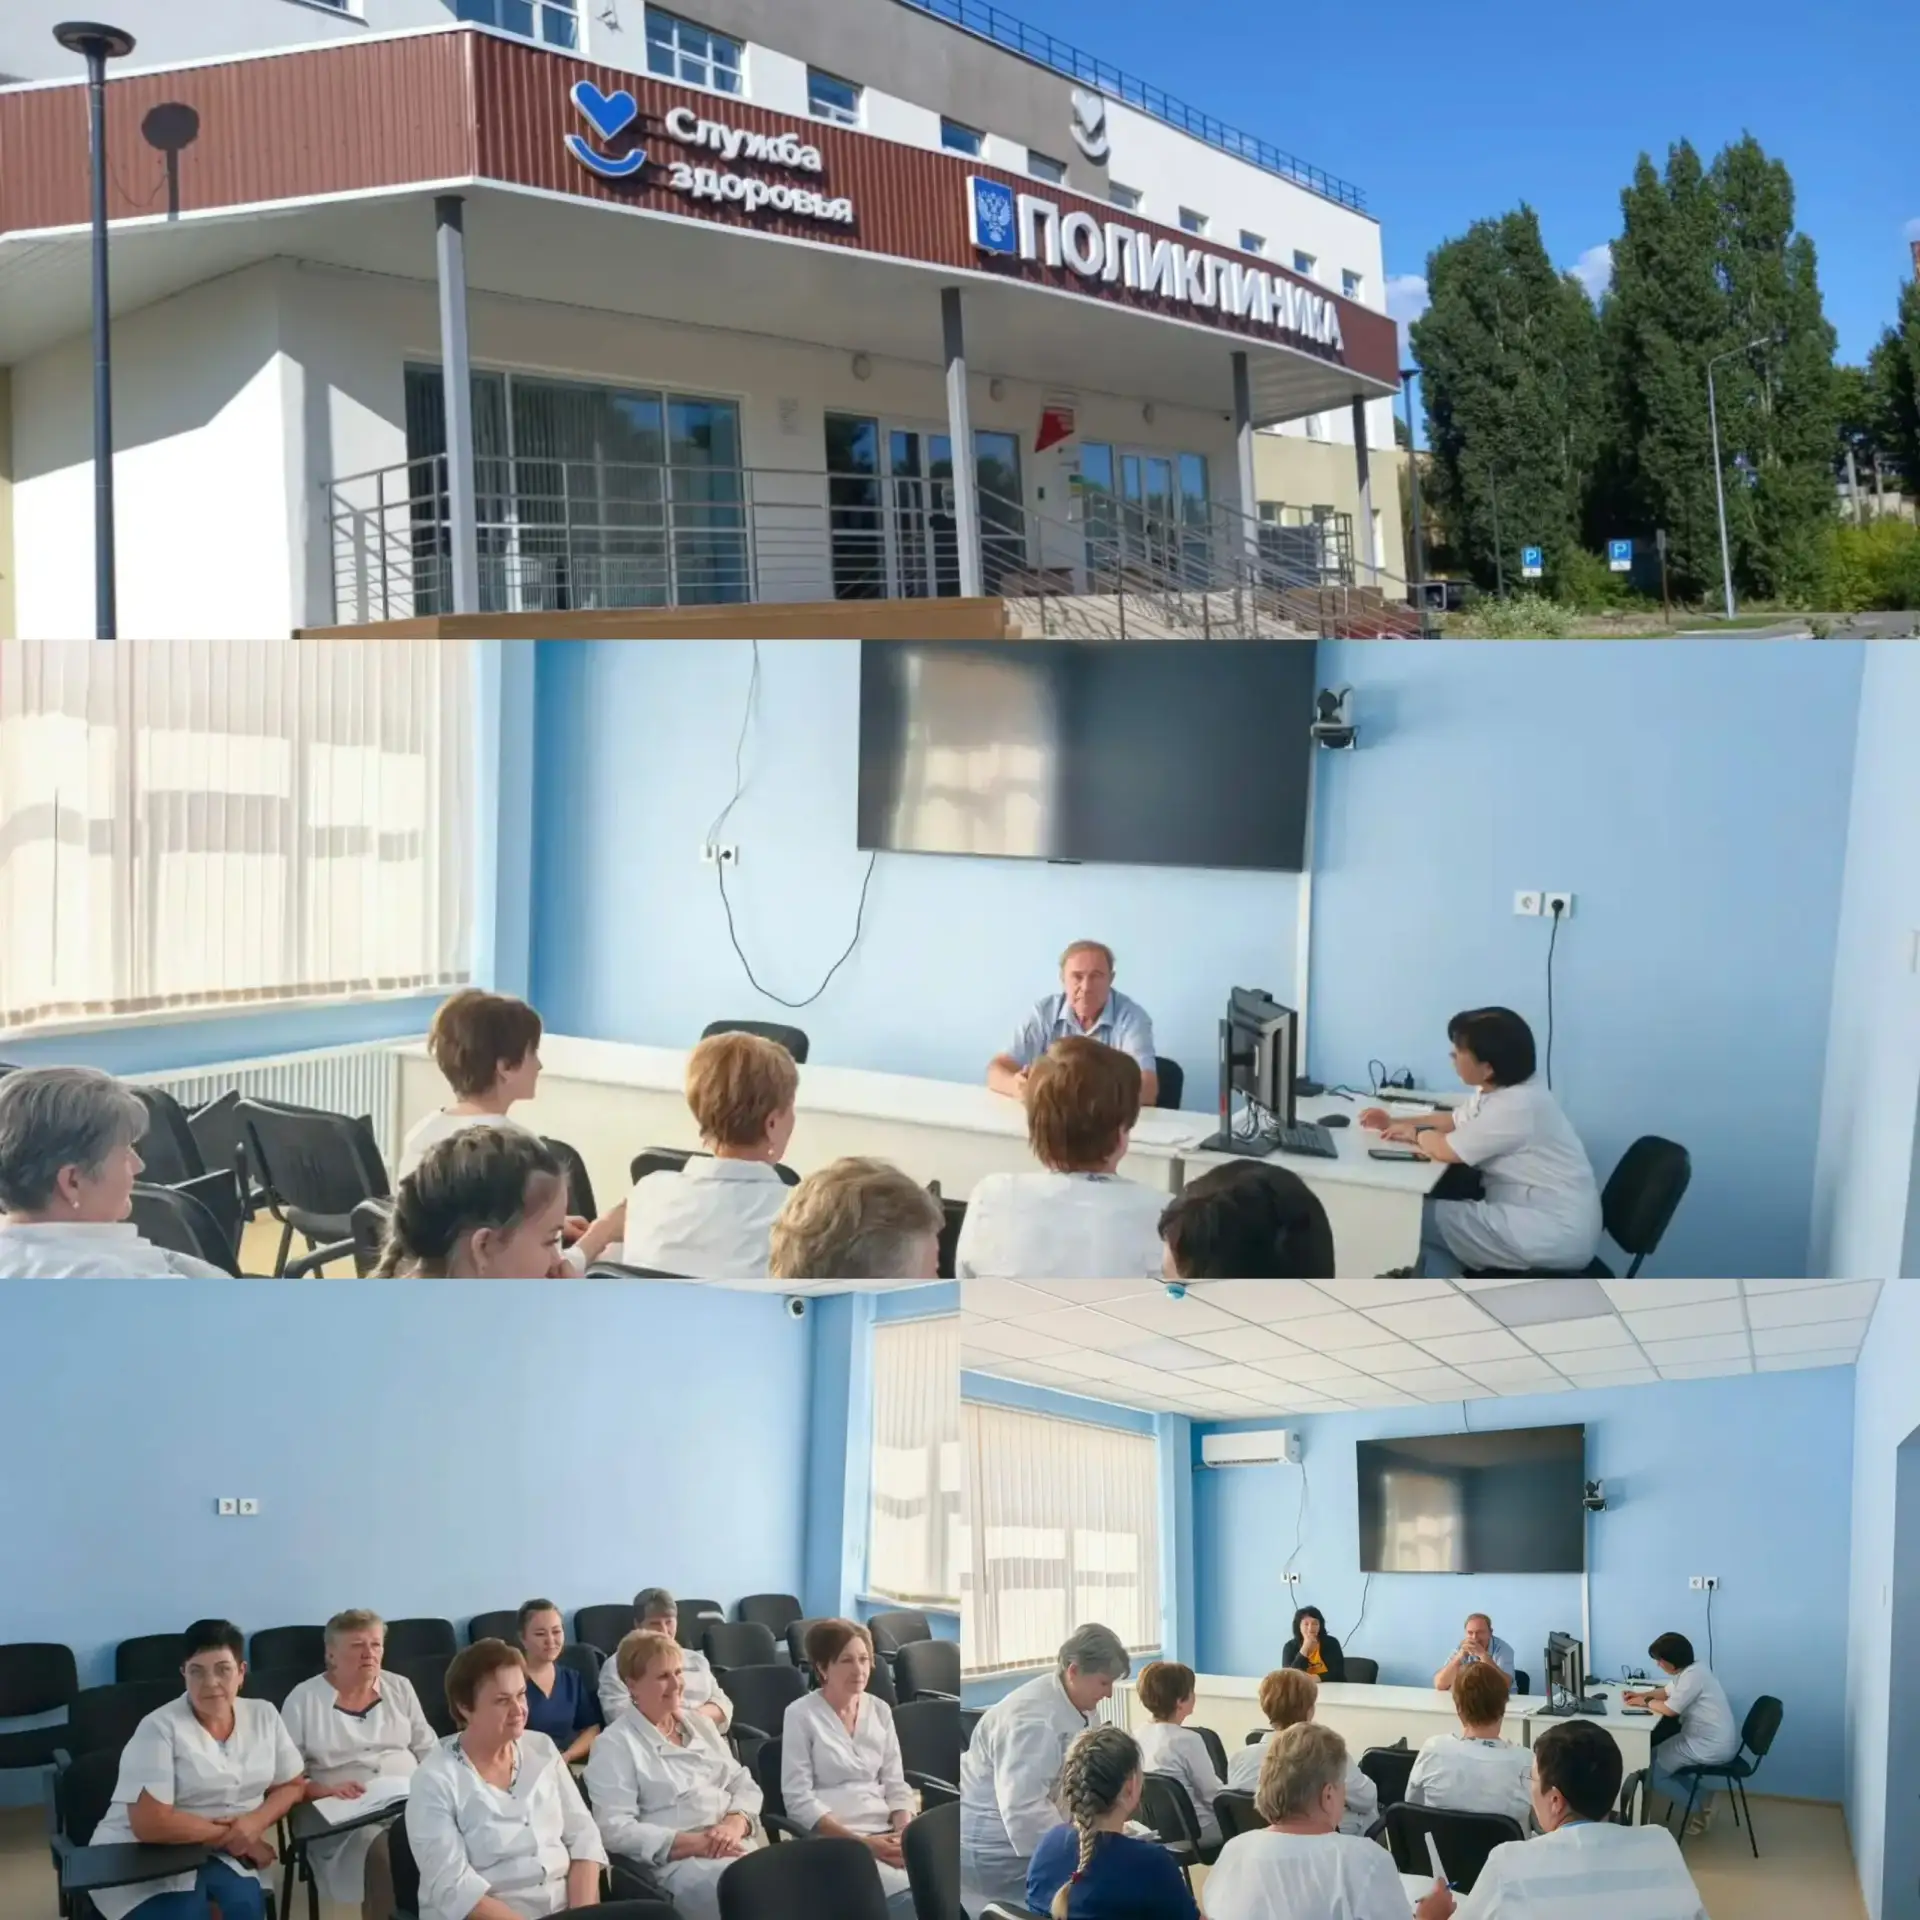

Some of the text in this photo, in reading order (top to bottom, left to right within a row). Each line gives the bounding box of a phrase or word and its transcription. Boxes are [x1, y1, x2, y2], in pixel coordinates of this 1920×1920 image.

[665, 106, 822, 173] Служба
[668, 161, 854, 224] здоровья
[1017, 193, 1344, 351] ПОЛИКЛИНИКА
[1525, 549, 1537, 564] P
[1614, 543, 1627, 558] P
